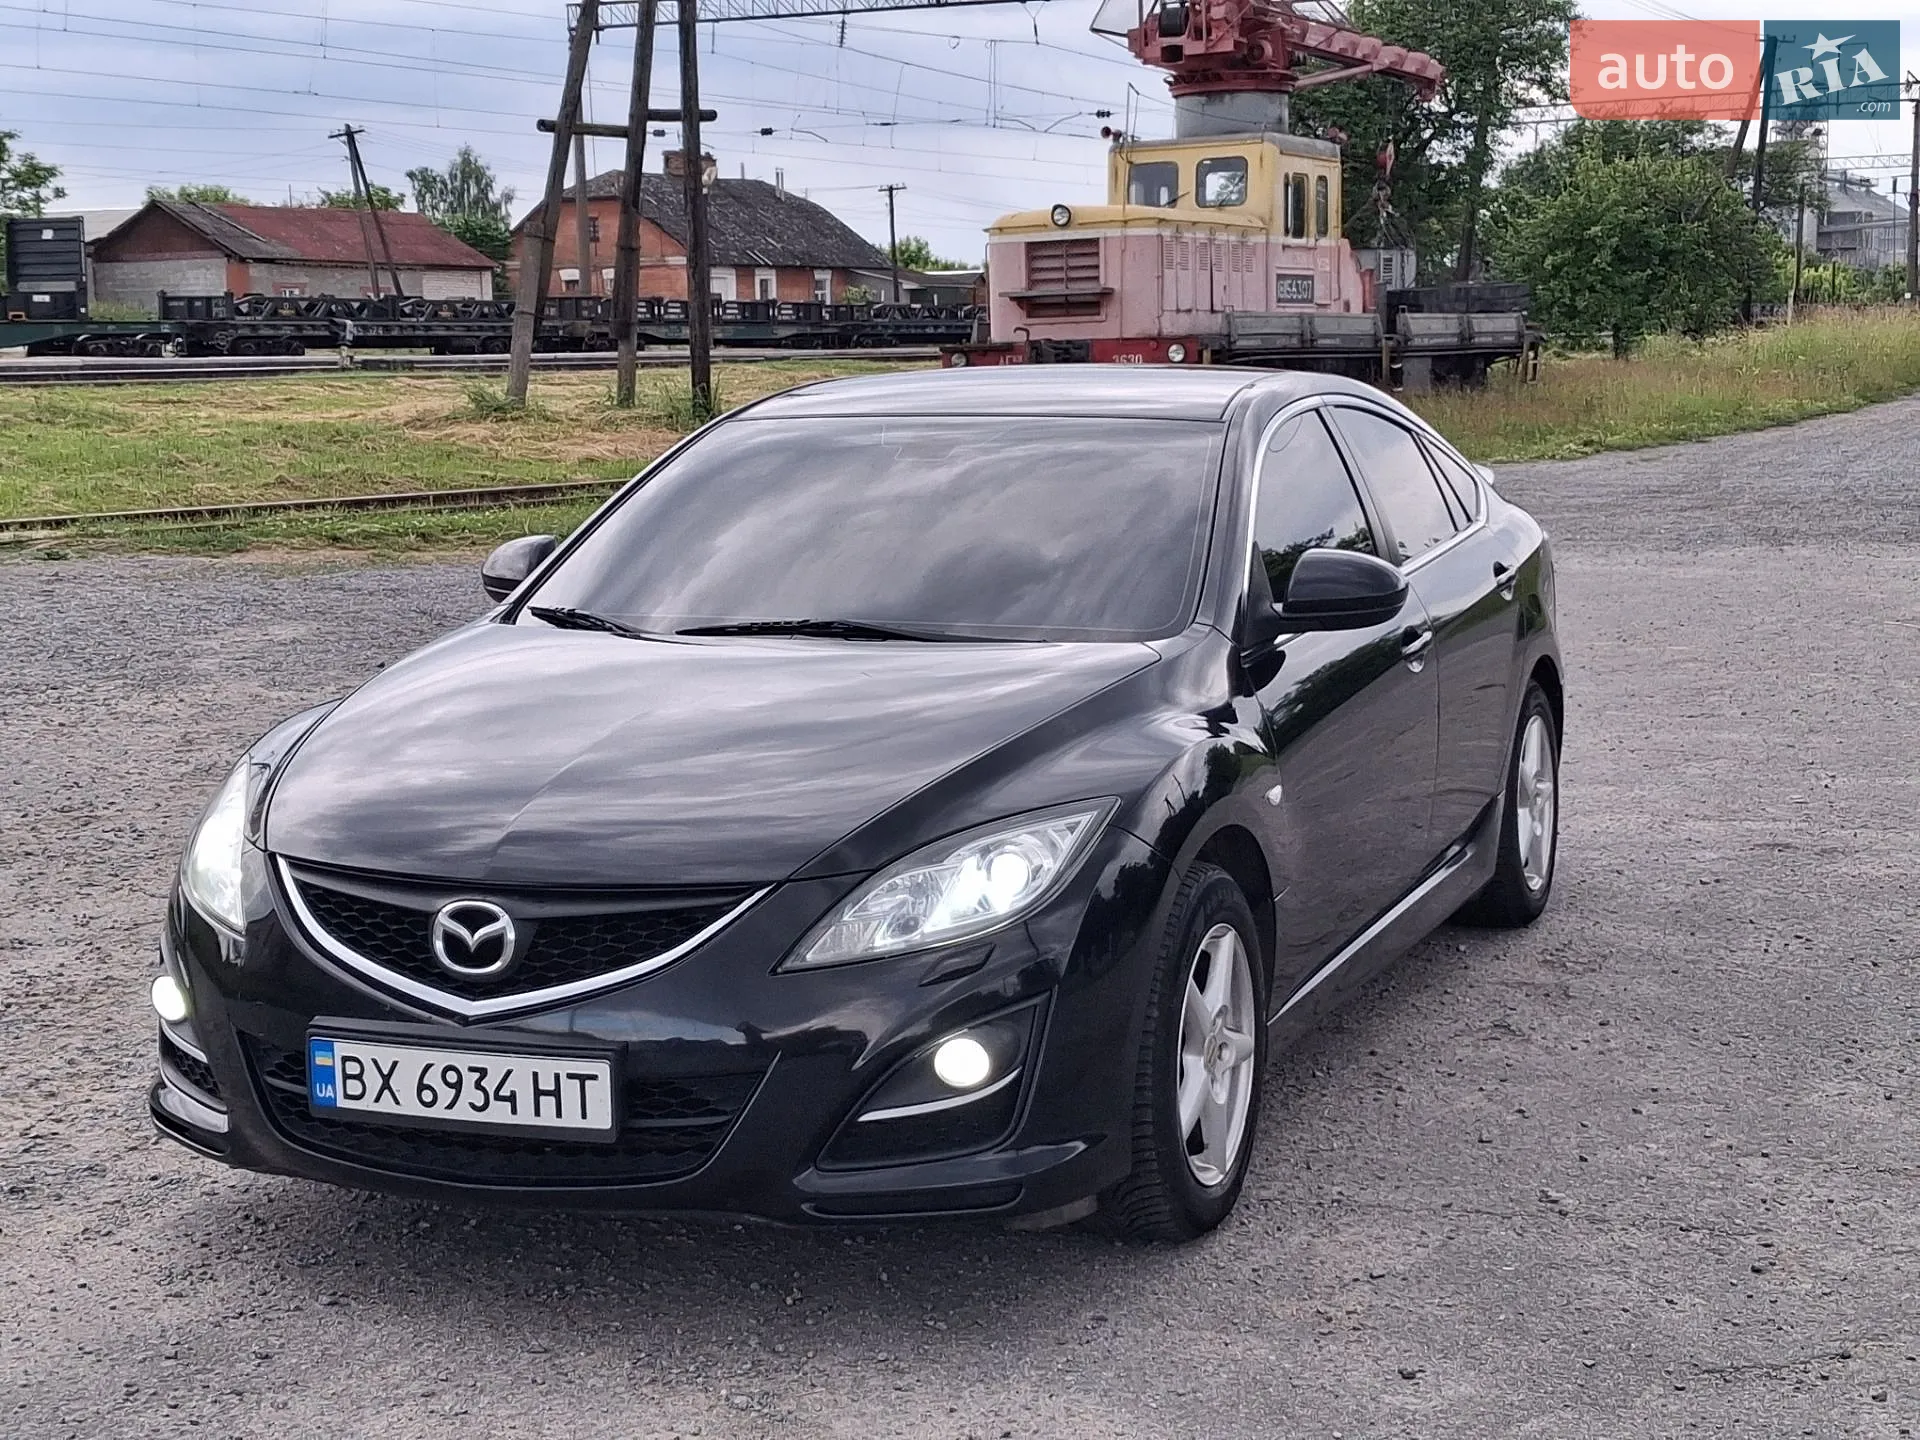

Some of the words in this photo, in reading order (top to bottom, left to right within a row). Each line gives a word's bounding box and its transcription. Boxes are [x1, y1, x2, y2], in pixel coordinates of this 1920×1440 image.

[317, 1083, 335, 1099] UA
[341, 1055, 402, 1107] BX
[416, 1063, 518, 1117] 6934
[532, 1071, 600, 1120] HT
